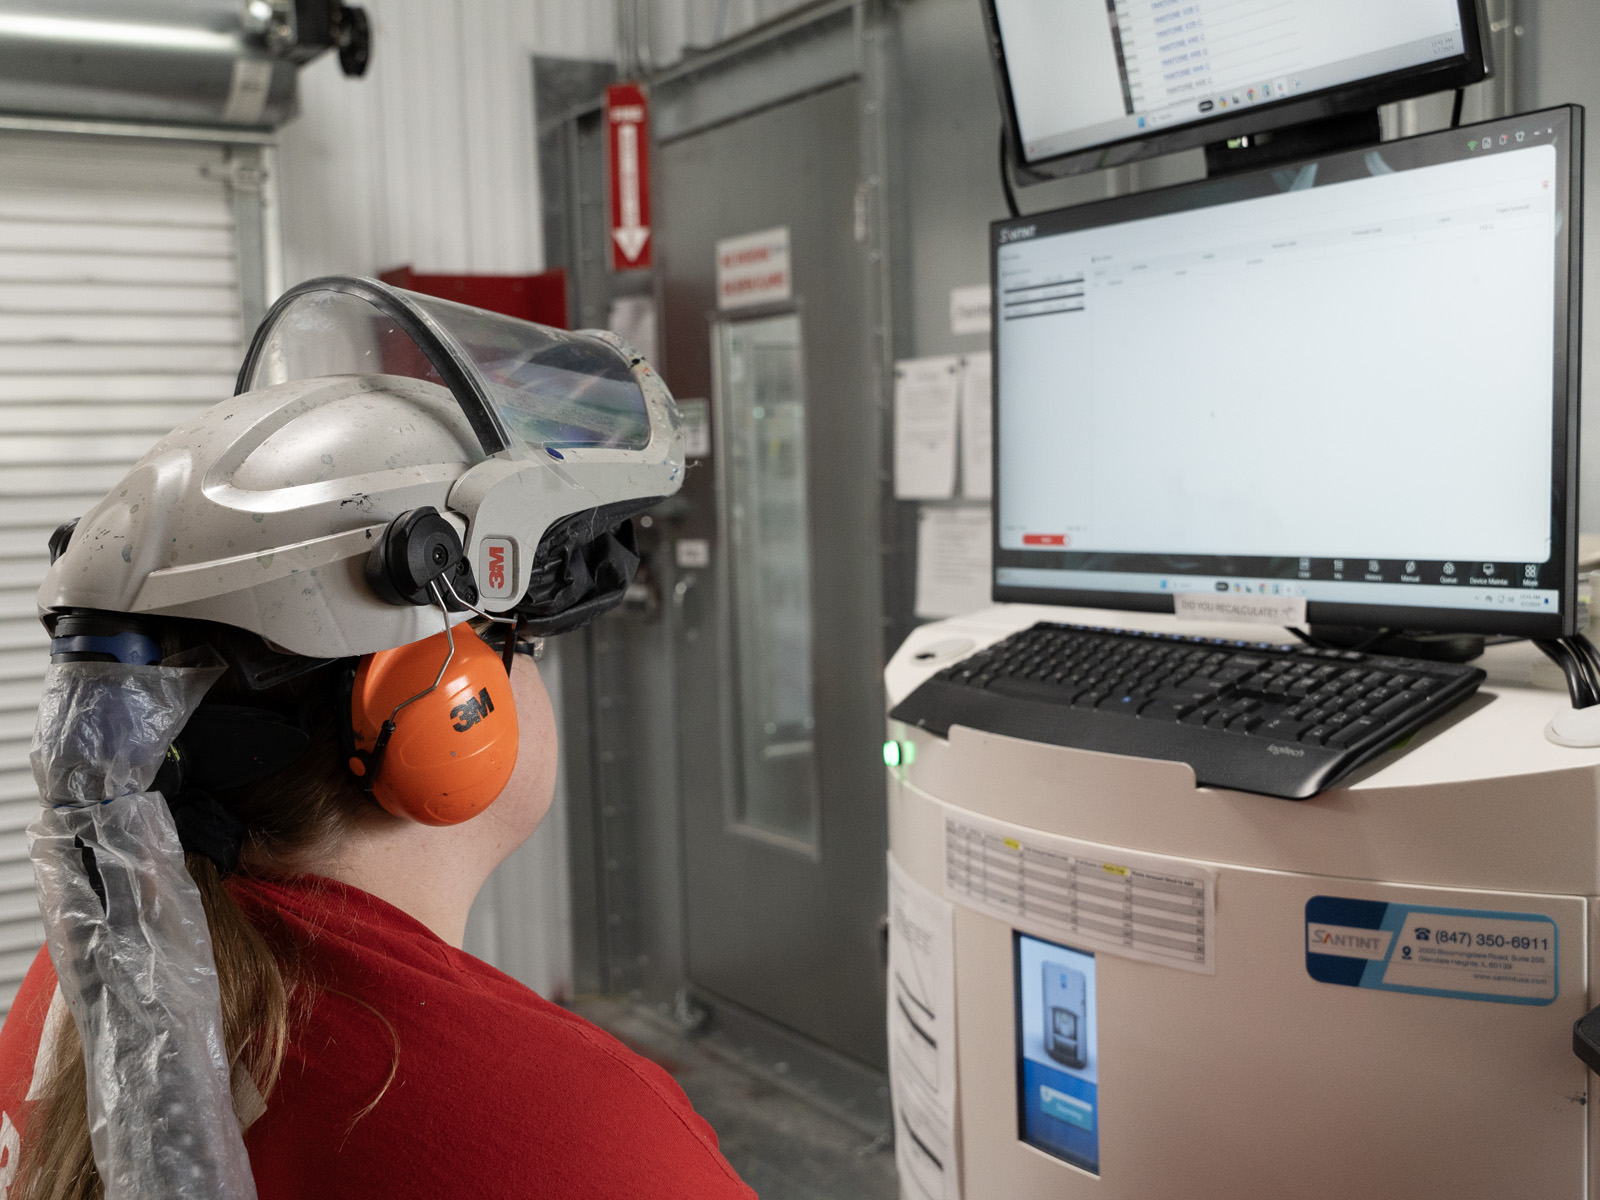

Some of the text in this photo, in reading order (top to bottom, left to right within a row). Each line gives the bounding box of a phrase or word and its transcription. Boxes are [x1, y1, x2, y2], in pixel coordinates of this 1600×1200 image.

[488, 546, 505, 589] 3M
[1522, 579, 1538, 587] More
[1181, 600, 1278, 617] DID YOU RECALCULATE?
[450, 687, 495, 733] 3M
[1311, 929, 1381, 950] SANTINT
[1435, 928, 1549, 951] (847) 350-6911
